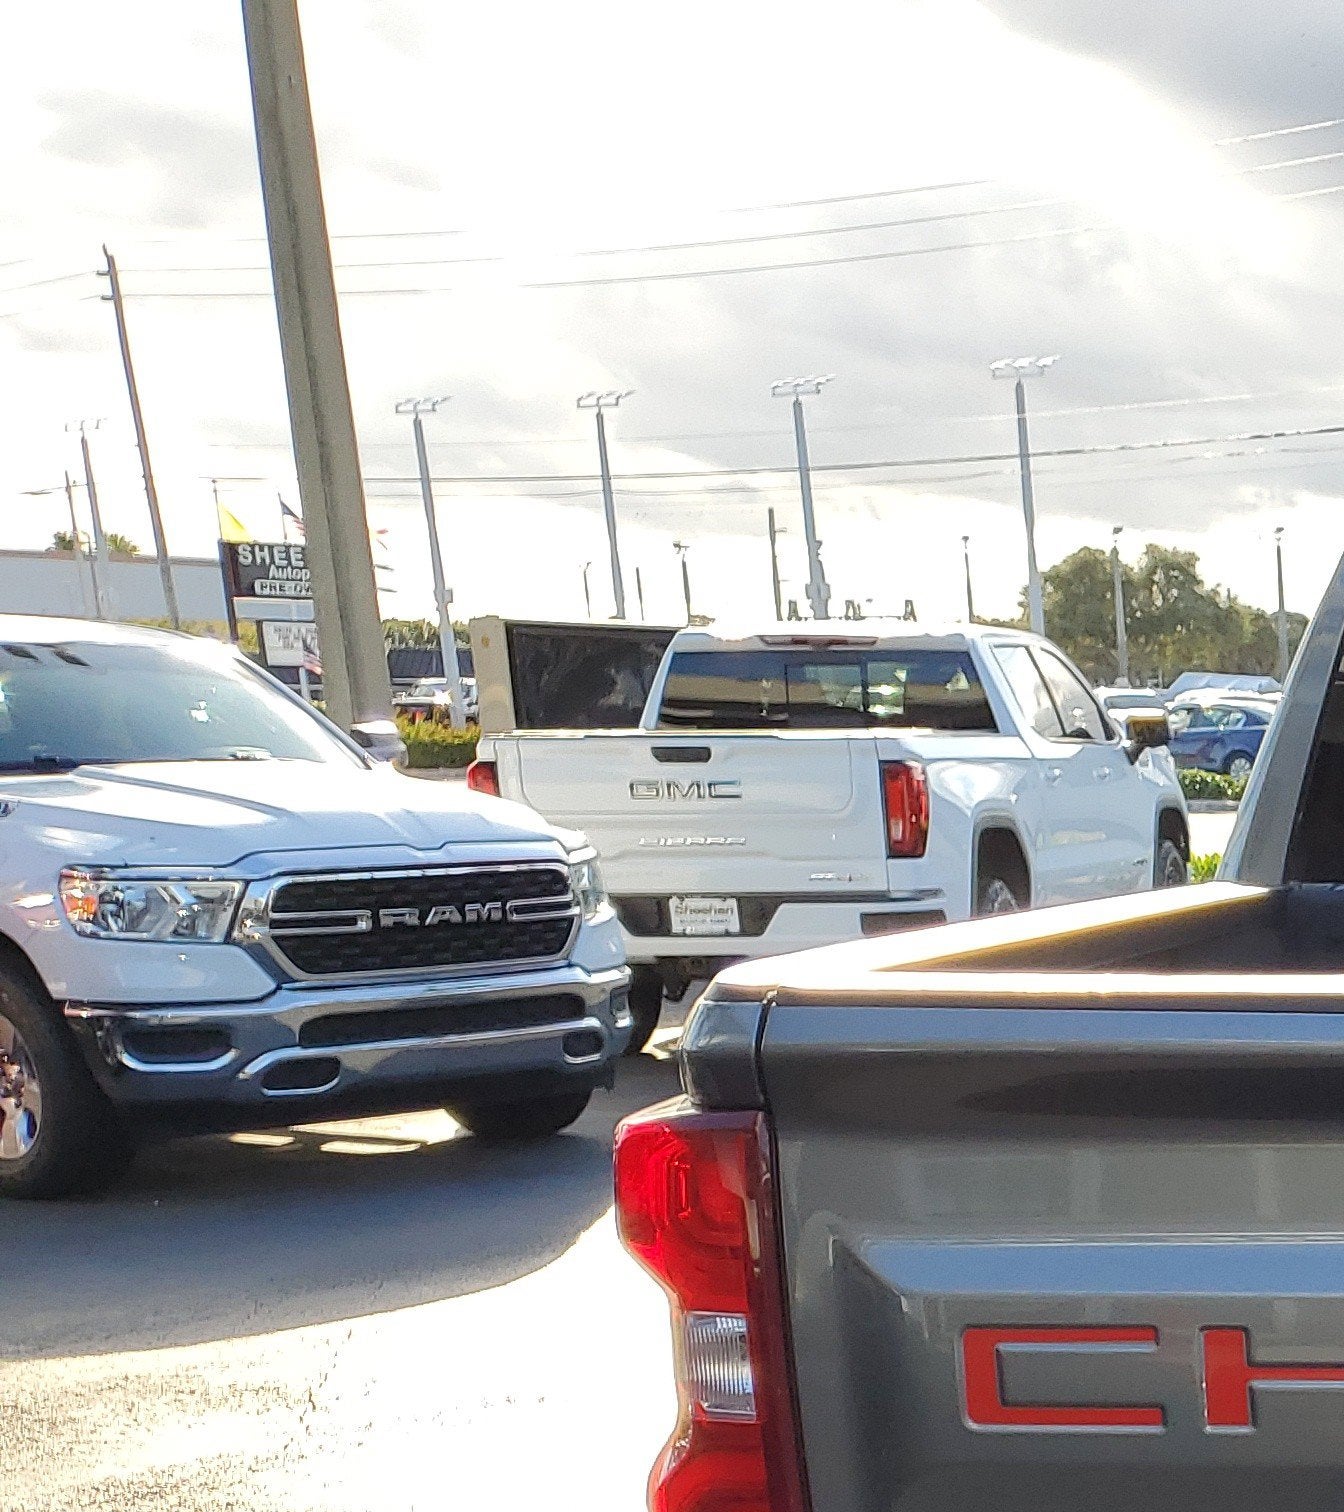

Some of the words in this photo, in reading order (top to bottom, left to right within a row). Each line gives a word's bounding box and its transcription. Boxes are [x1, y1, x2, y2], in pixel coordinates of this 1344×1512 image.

[238, 543, 305, 567] SHEE
[629, 779, 743, 801] GMC
[378, 901, 502, 928] RAM
